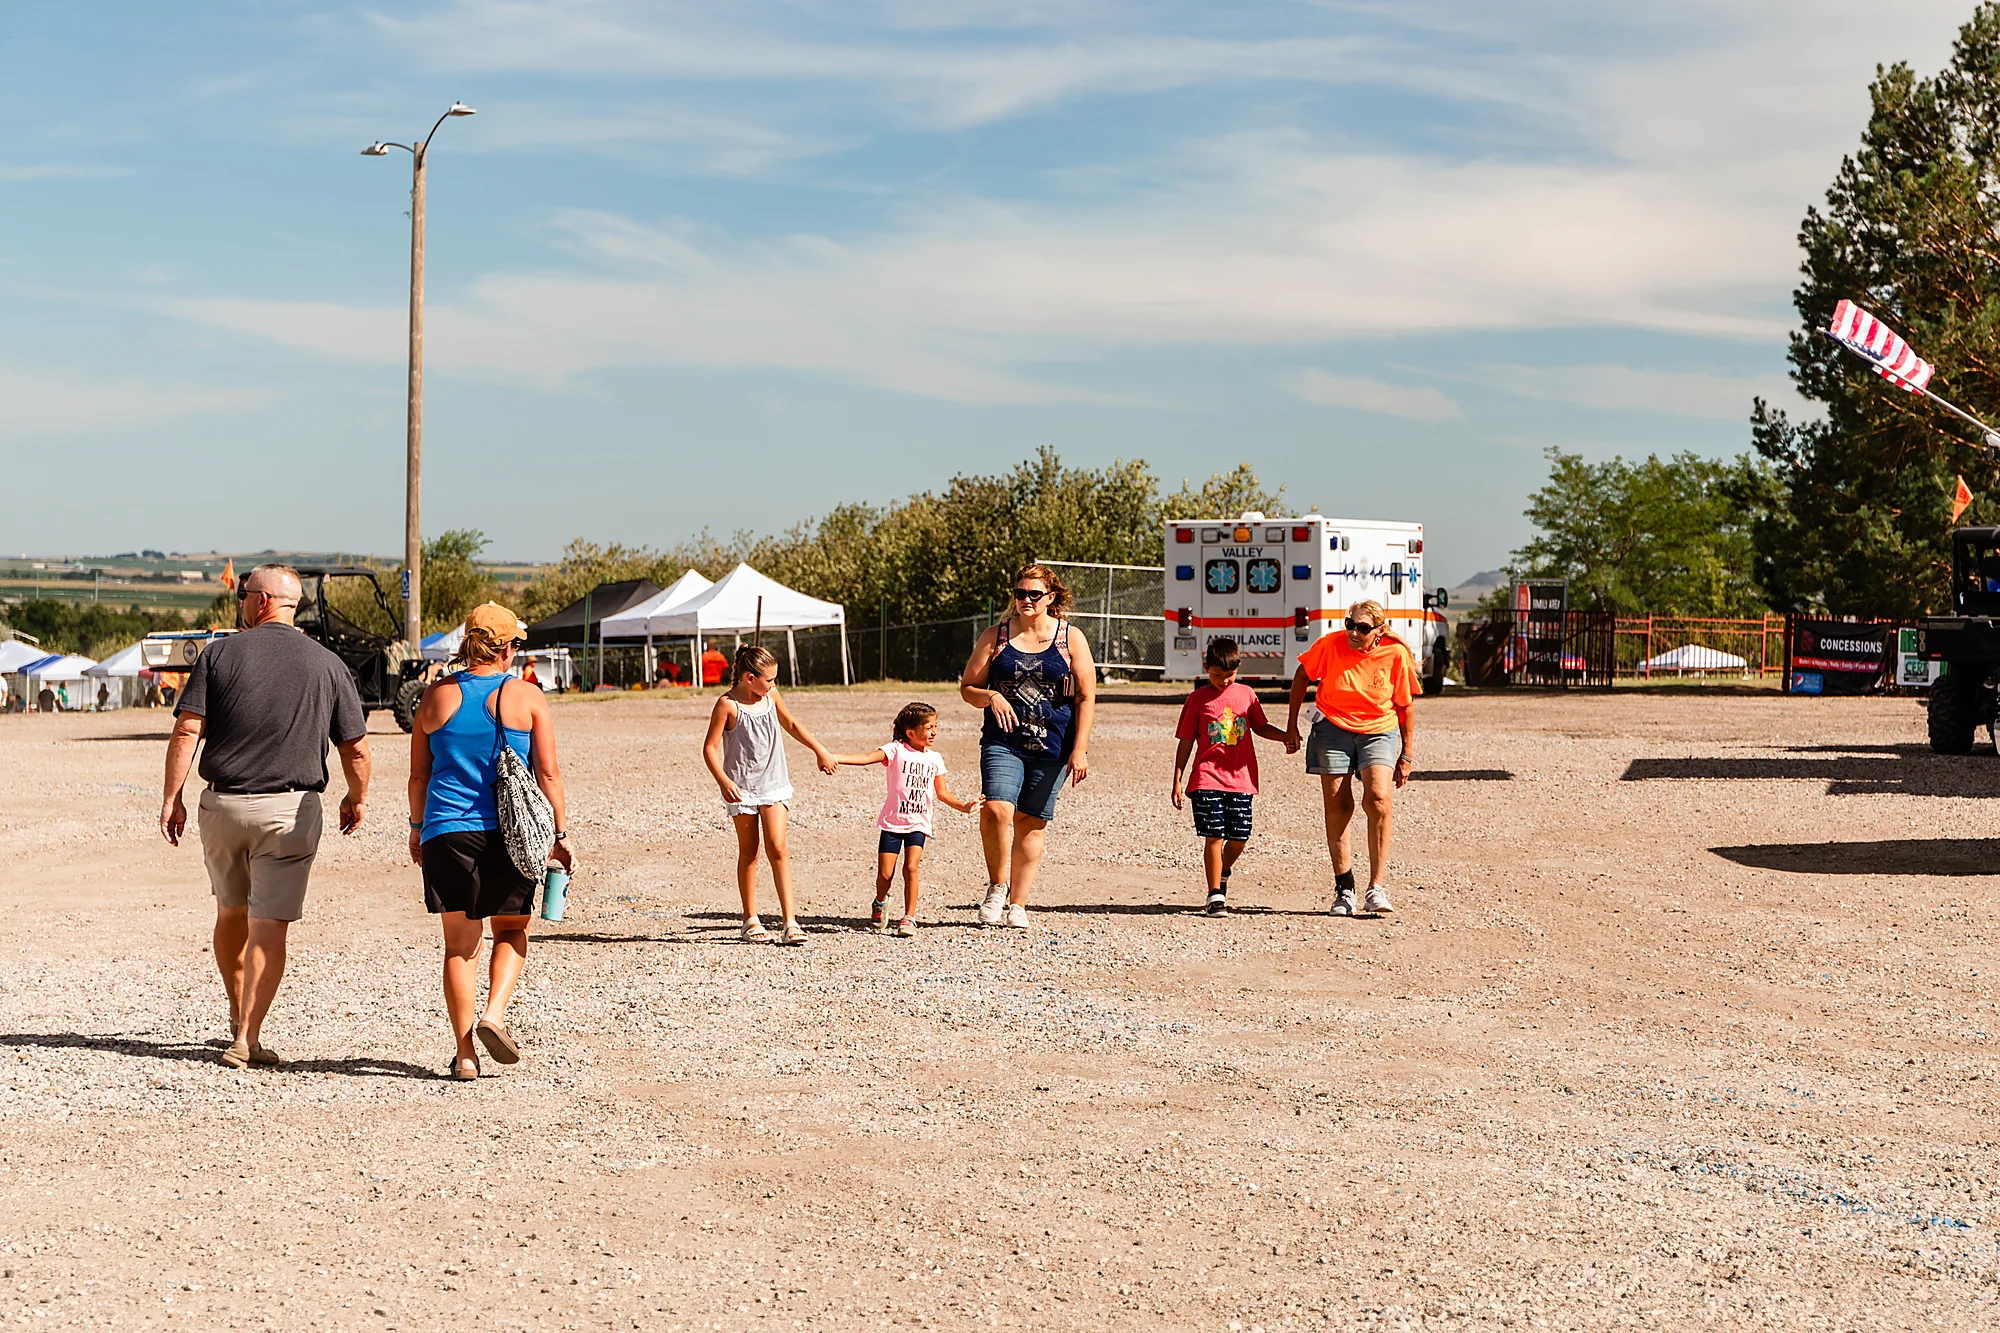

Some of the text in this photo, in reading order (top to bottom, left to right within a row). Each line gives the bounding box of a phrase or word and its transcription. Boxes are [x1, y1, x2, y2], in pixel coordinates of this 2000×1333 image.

[1222, 547, 1263, 558] VALLEY
[1206, 634, 1281, 645] AULANCE
[1820, 638, 1882, 653] CONCESSIONS
[902, 760, 907, 773] I
[905, 774, 929, 790] FROM
[908, 789, 926, 801] MY
